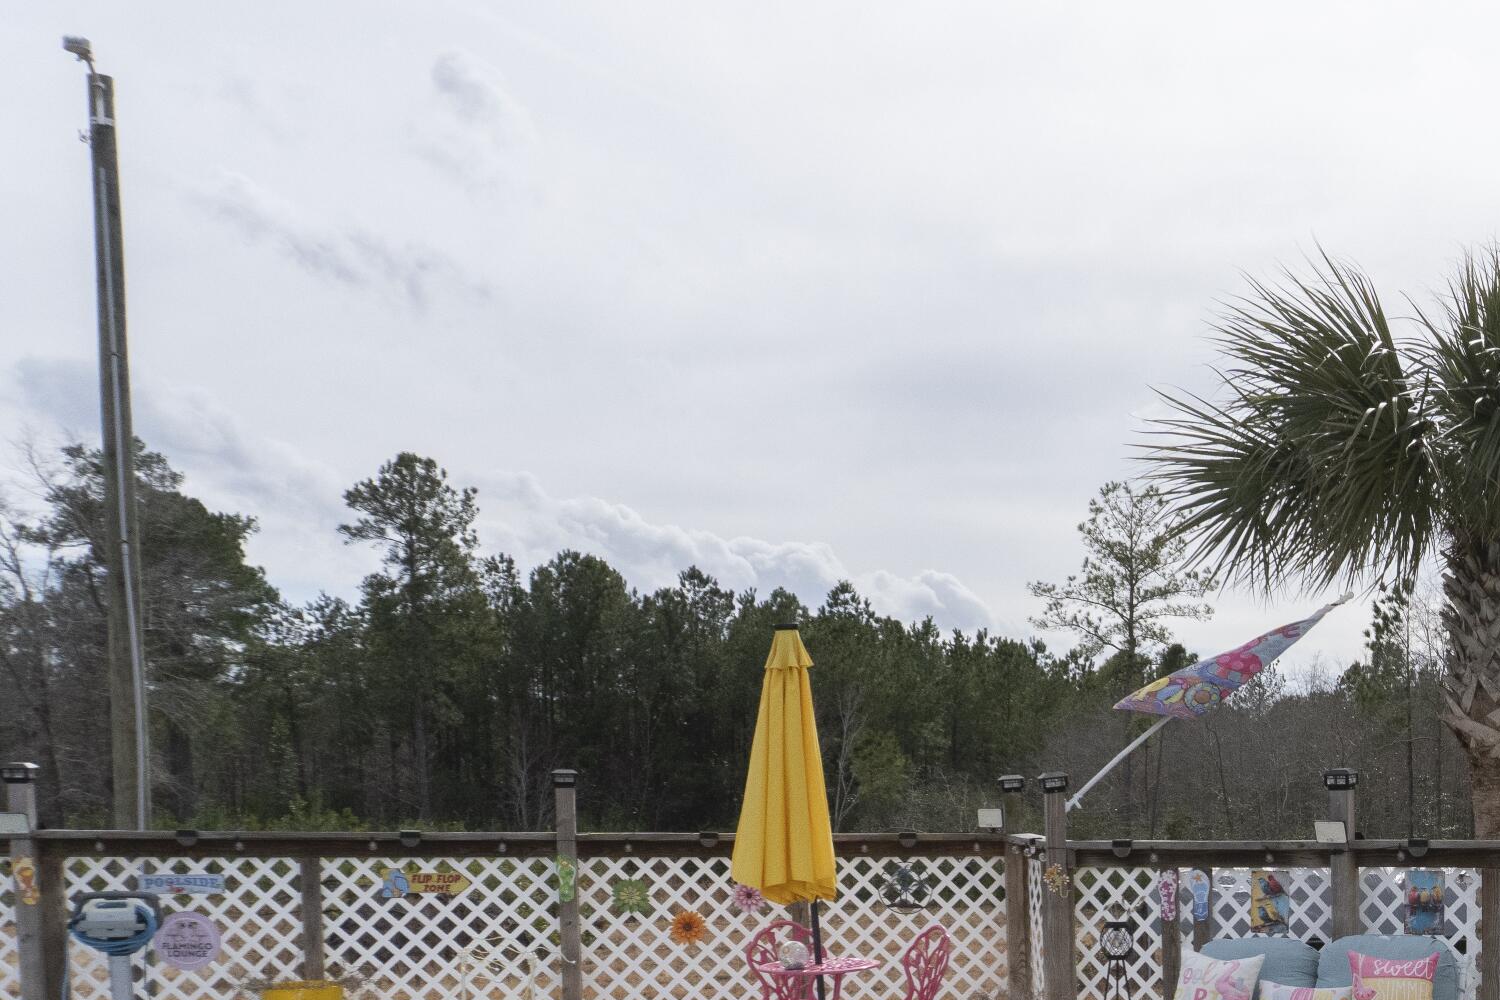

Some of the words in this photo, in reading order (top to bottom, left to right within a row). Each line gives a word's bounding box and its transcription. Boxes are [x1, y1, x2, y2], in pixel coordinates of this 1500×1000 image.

[144, 877, 218, 889] POOLSIDE
[411, 874, 433, 883] FLIP
[437, 874, 461, 883] FLOP
[424, 884, 451, 892] ZONE
[161, 942, 214, 950] FLAMINGO
[167, 950, 209, 958] LOUNGE
[1182, 960, 1219, 985] ool
[1374, 957, 1433, 980] sweet
